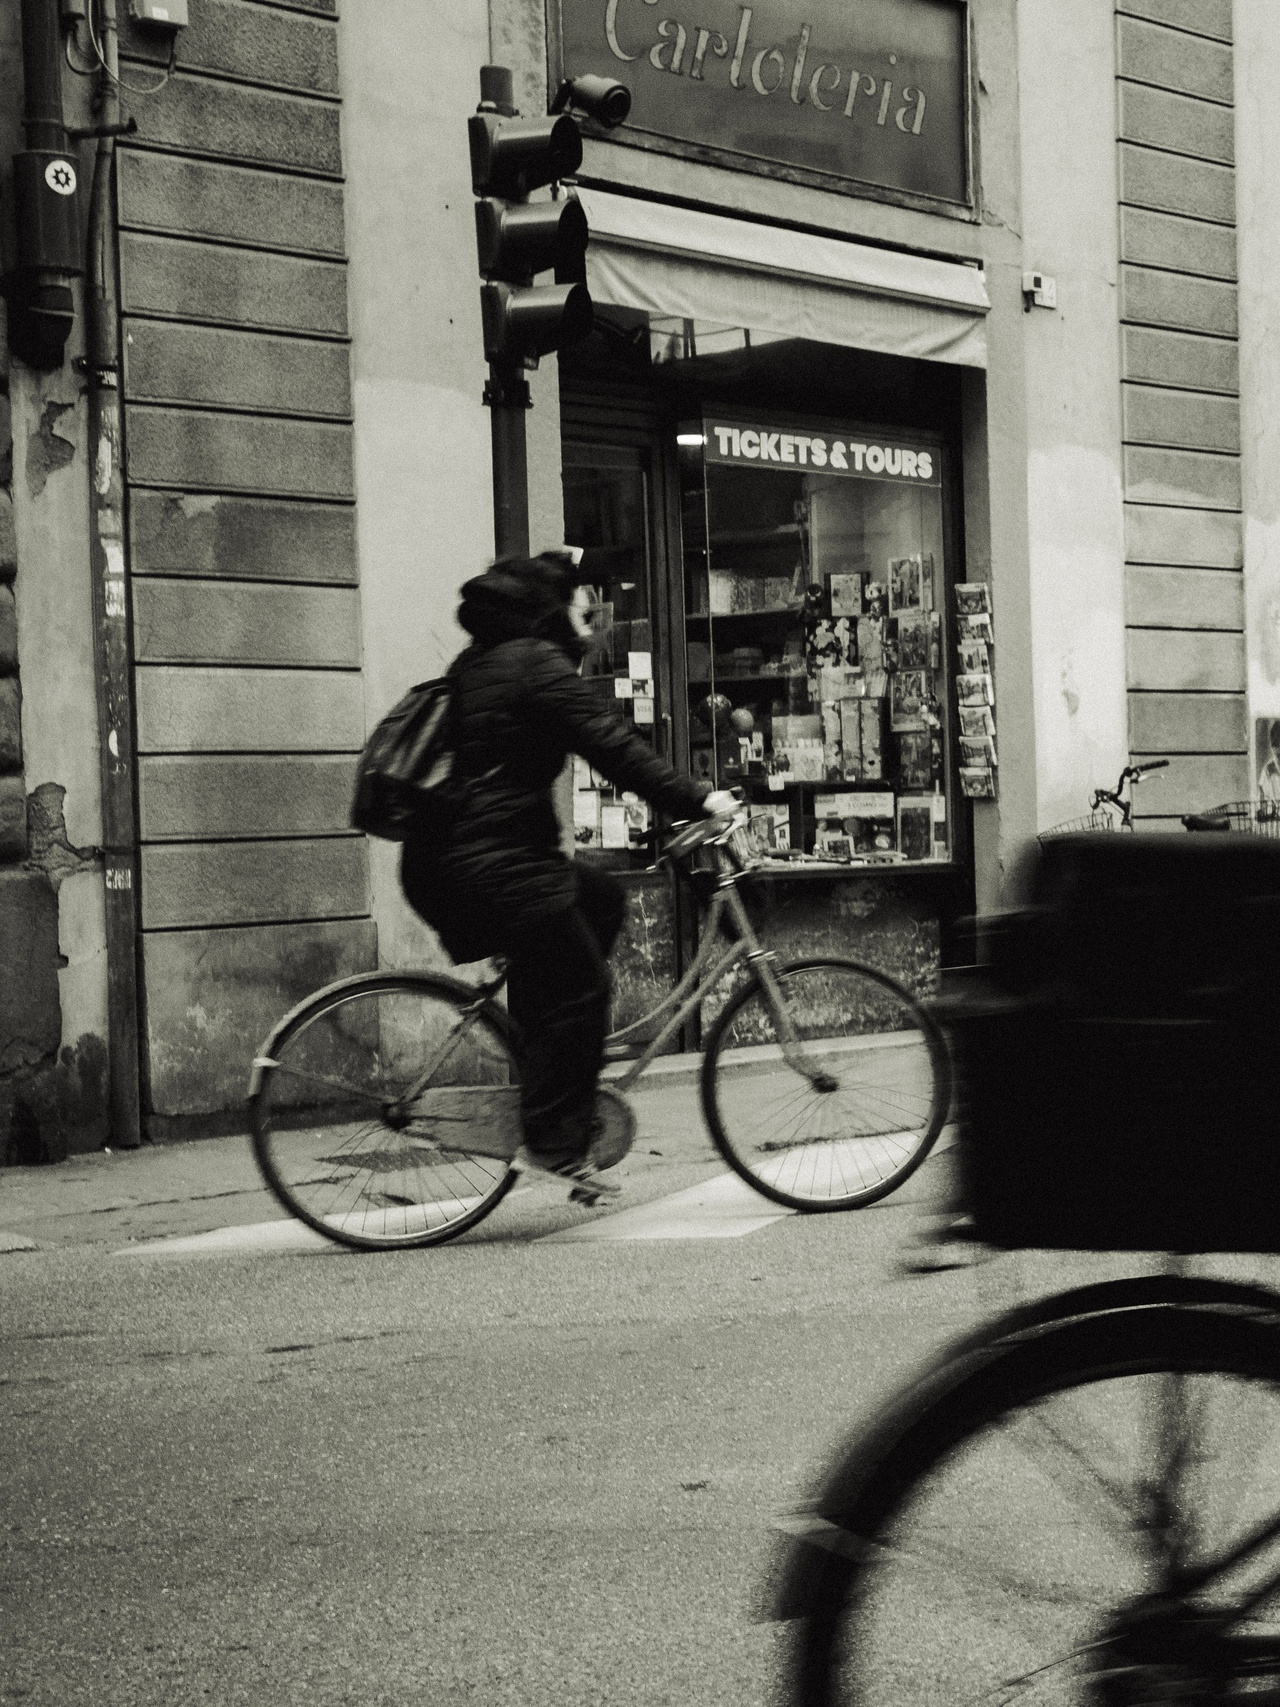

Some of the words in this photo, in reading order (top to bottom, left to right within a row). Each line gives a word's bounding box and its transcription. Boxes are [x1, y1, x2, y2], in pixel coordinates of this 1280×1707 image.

[714, 426, 828, 466] TICKETS
[829, 440, 848, 469] &
[850, 443, 933, 479] TOURS
